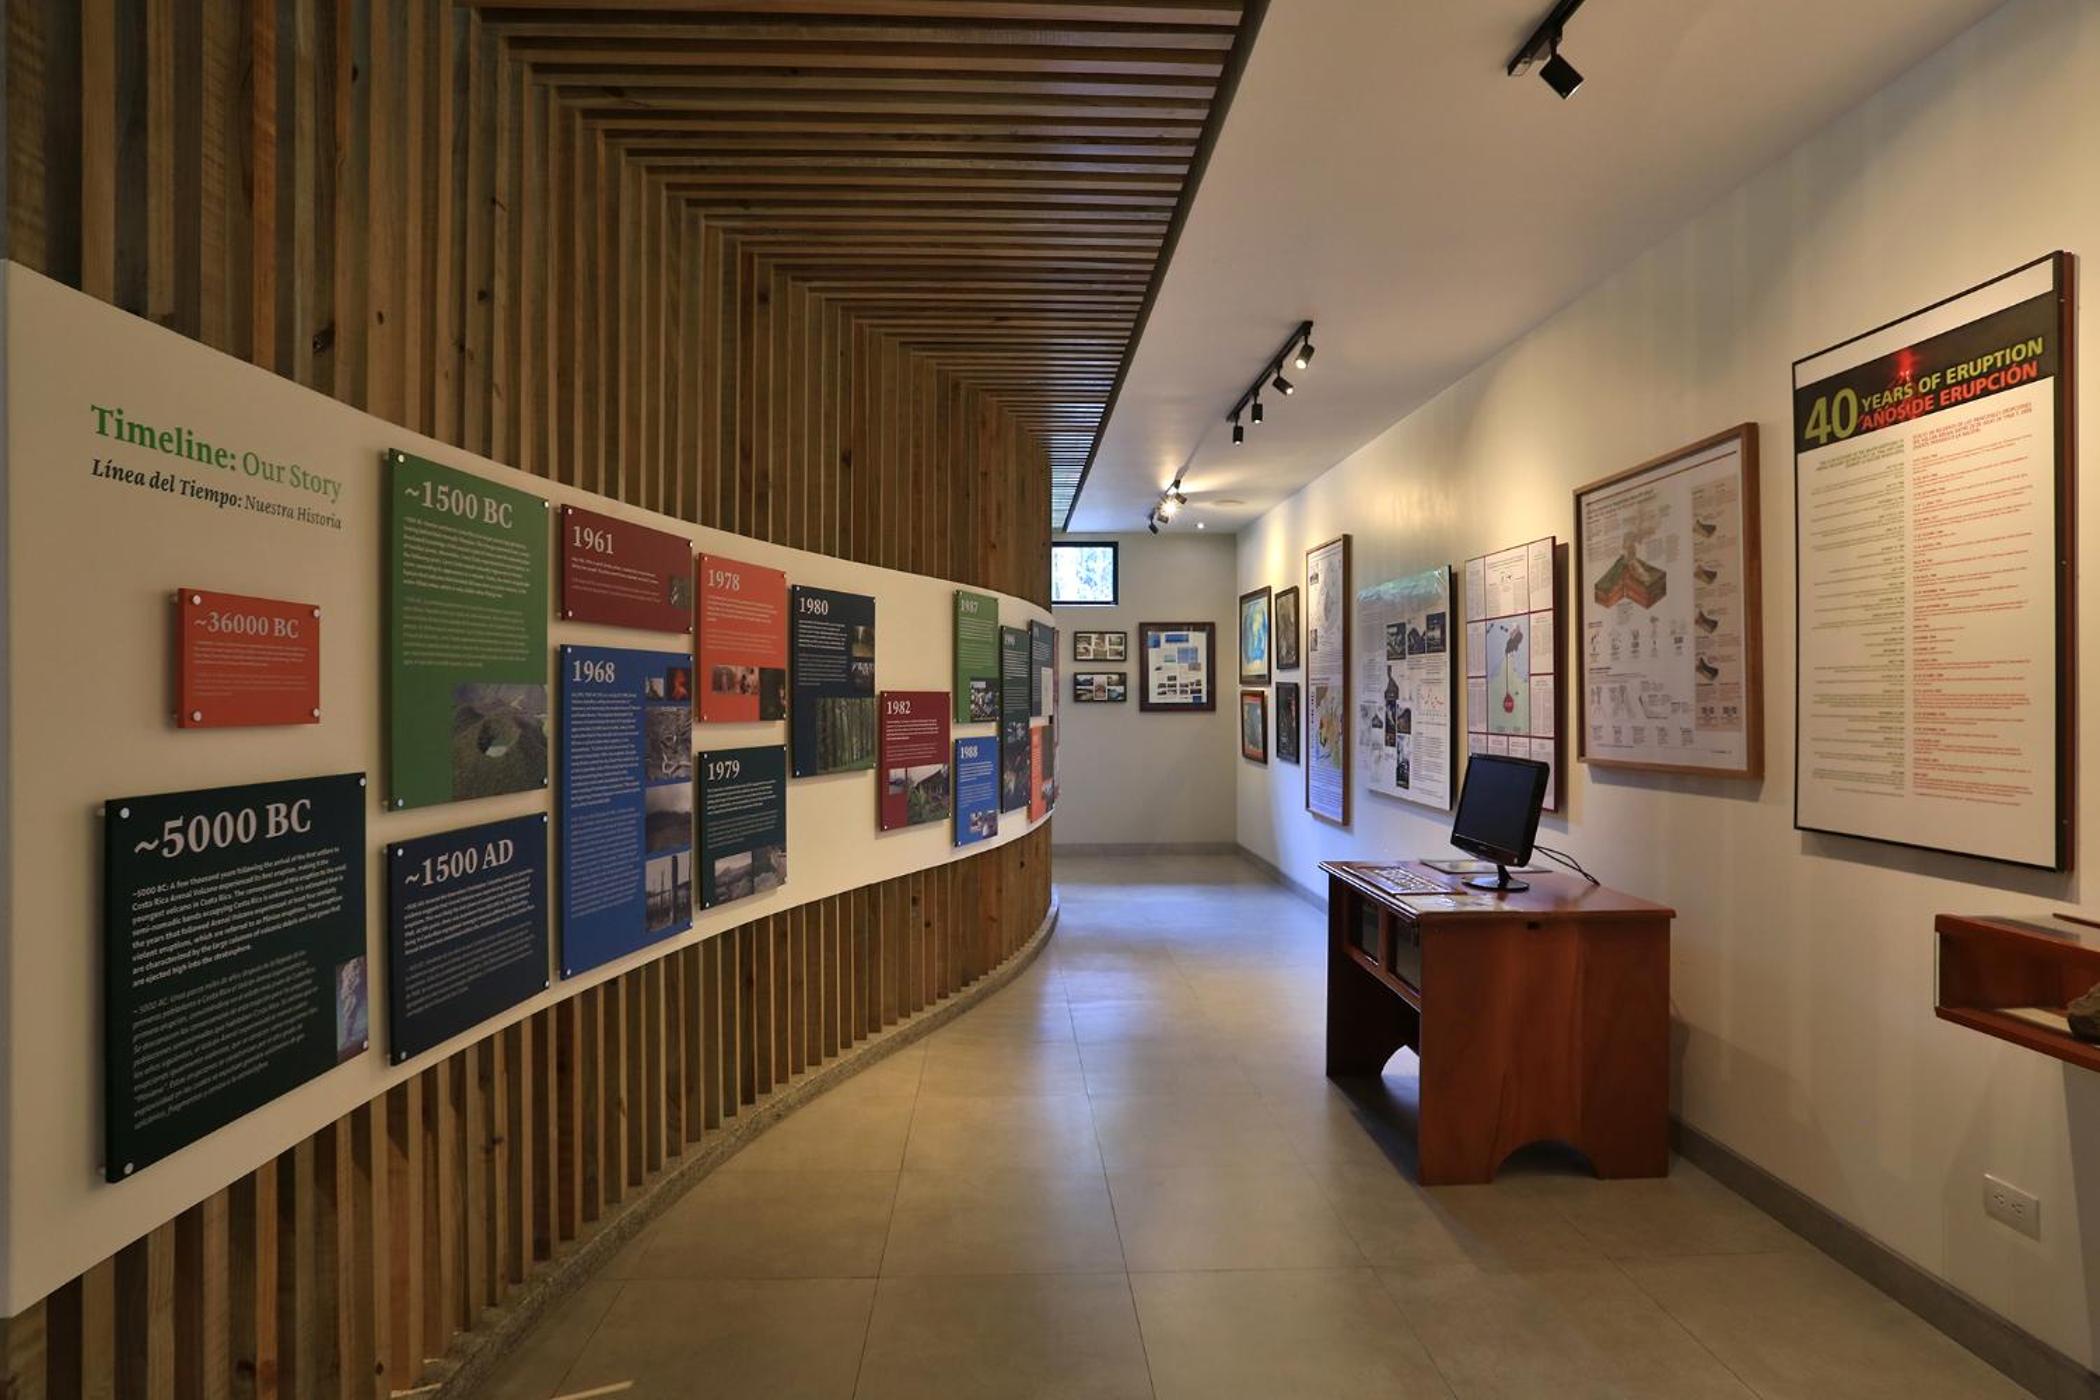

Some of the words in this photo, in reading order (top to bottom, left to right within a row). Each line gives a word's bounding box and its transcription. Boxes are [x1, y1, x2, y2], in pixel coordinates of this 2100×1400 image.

[1861, 383, 1912, 410] YEARS
[1918, 372, 1941, 394] OF
[1946, 337, 2044, 384] ERUPTION
[1940, 359, 2039, 407] ERUPCIÓN
[1804, 387, 1858, 444] 40
[90, 404, 236, 471] Timeline:
[243, 451, 287, 483] Our
[290, 466, 342, 504] Story
[91, 459, 145, 487] Línea
[149, 471, 174, 493] del
[180, 478, 242, 509] Tiempo:
[244, 495, 294, 519] Nuestra
[298, 507, 342, 530] Historia
[405, 481, 478, 519] ~1500
[484, 497, 513, 528] BC
[573, 526, 614, 554] 1961
[707, 569, 740, 592] 1978
[194, 611, 268, 637] ~36000
[274, 618, 299, 639] BC
[799, 597, 829, 616] 1980
[572, 660, 615, 684] 1968
[887, 700, 911, 715] 1982
[707, 760, 740, 781] 1979
[960, 746, 978, 759] 1988
[135, 808, 257, 858] ~5000
[266, 798, 311, 839] BC
[405, 847, 478, 887] ~1500
[482, 839, 514, 869] AD
